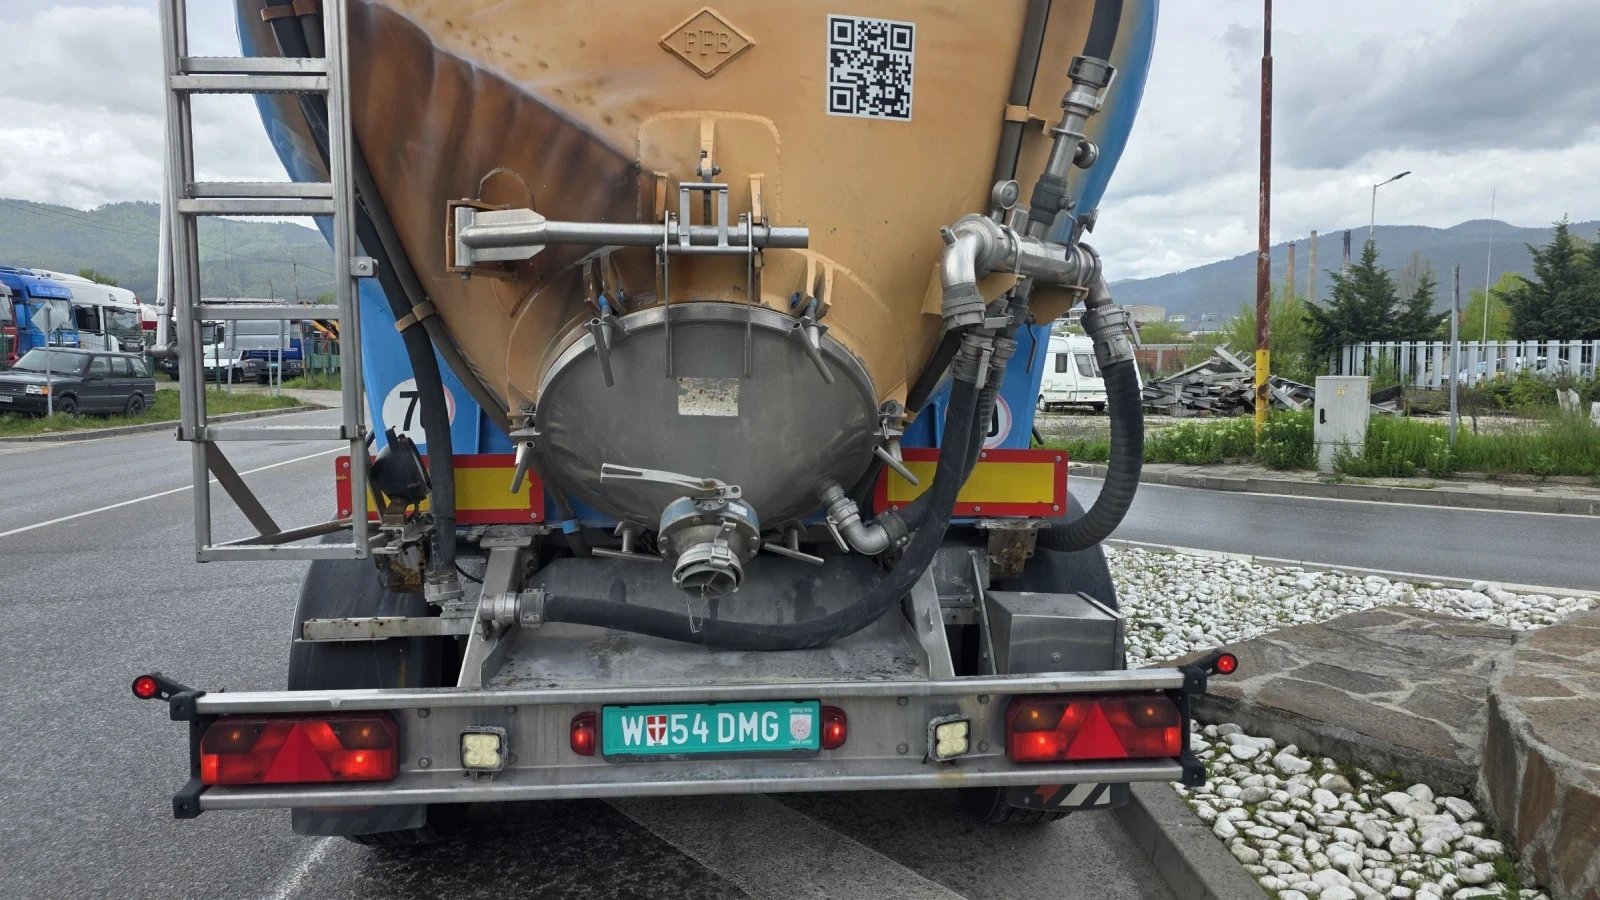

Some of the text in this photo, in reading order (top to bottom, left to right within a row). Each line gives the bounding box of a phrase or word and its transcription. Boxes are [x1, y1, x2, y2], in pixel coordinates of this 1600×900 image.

[621, 711, 779, 746] W 54 DMG
